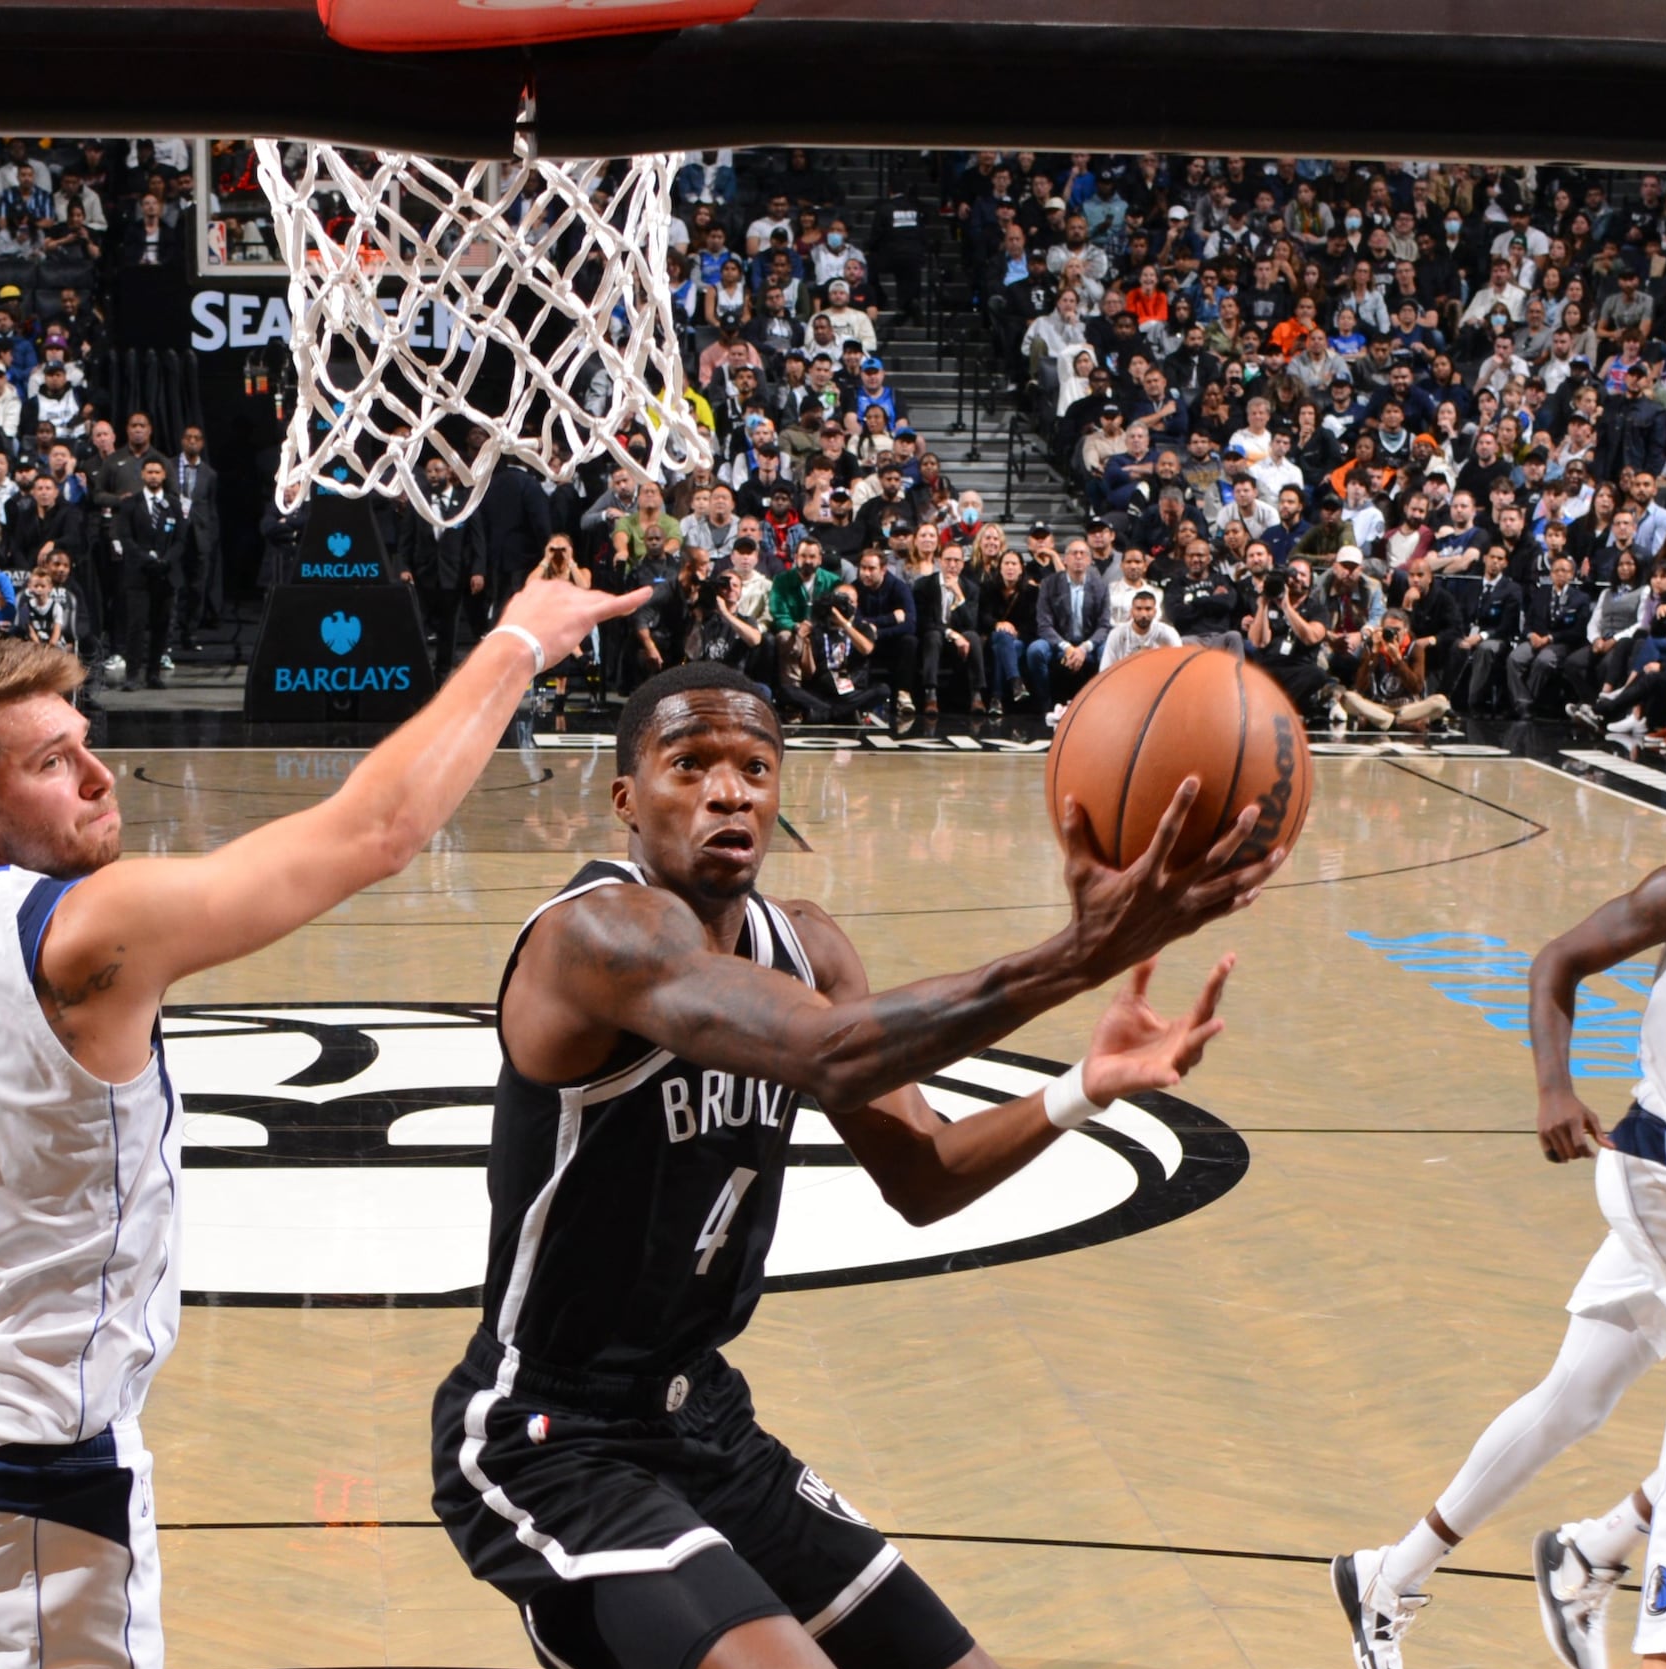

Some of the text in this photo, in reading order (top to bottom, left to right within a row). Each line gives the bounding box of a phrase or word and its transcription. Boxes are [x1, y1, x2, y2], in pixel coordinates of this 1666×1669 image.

[301, 563, 379, 578] BARCLAYS
[275, 666, 411, 692] BARCLAYS
[693, 1166, 758, 1276] 4
